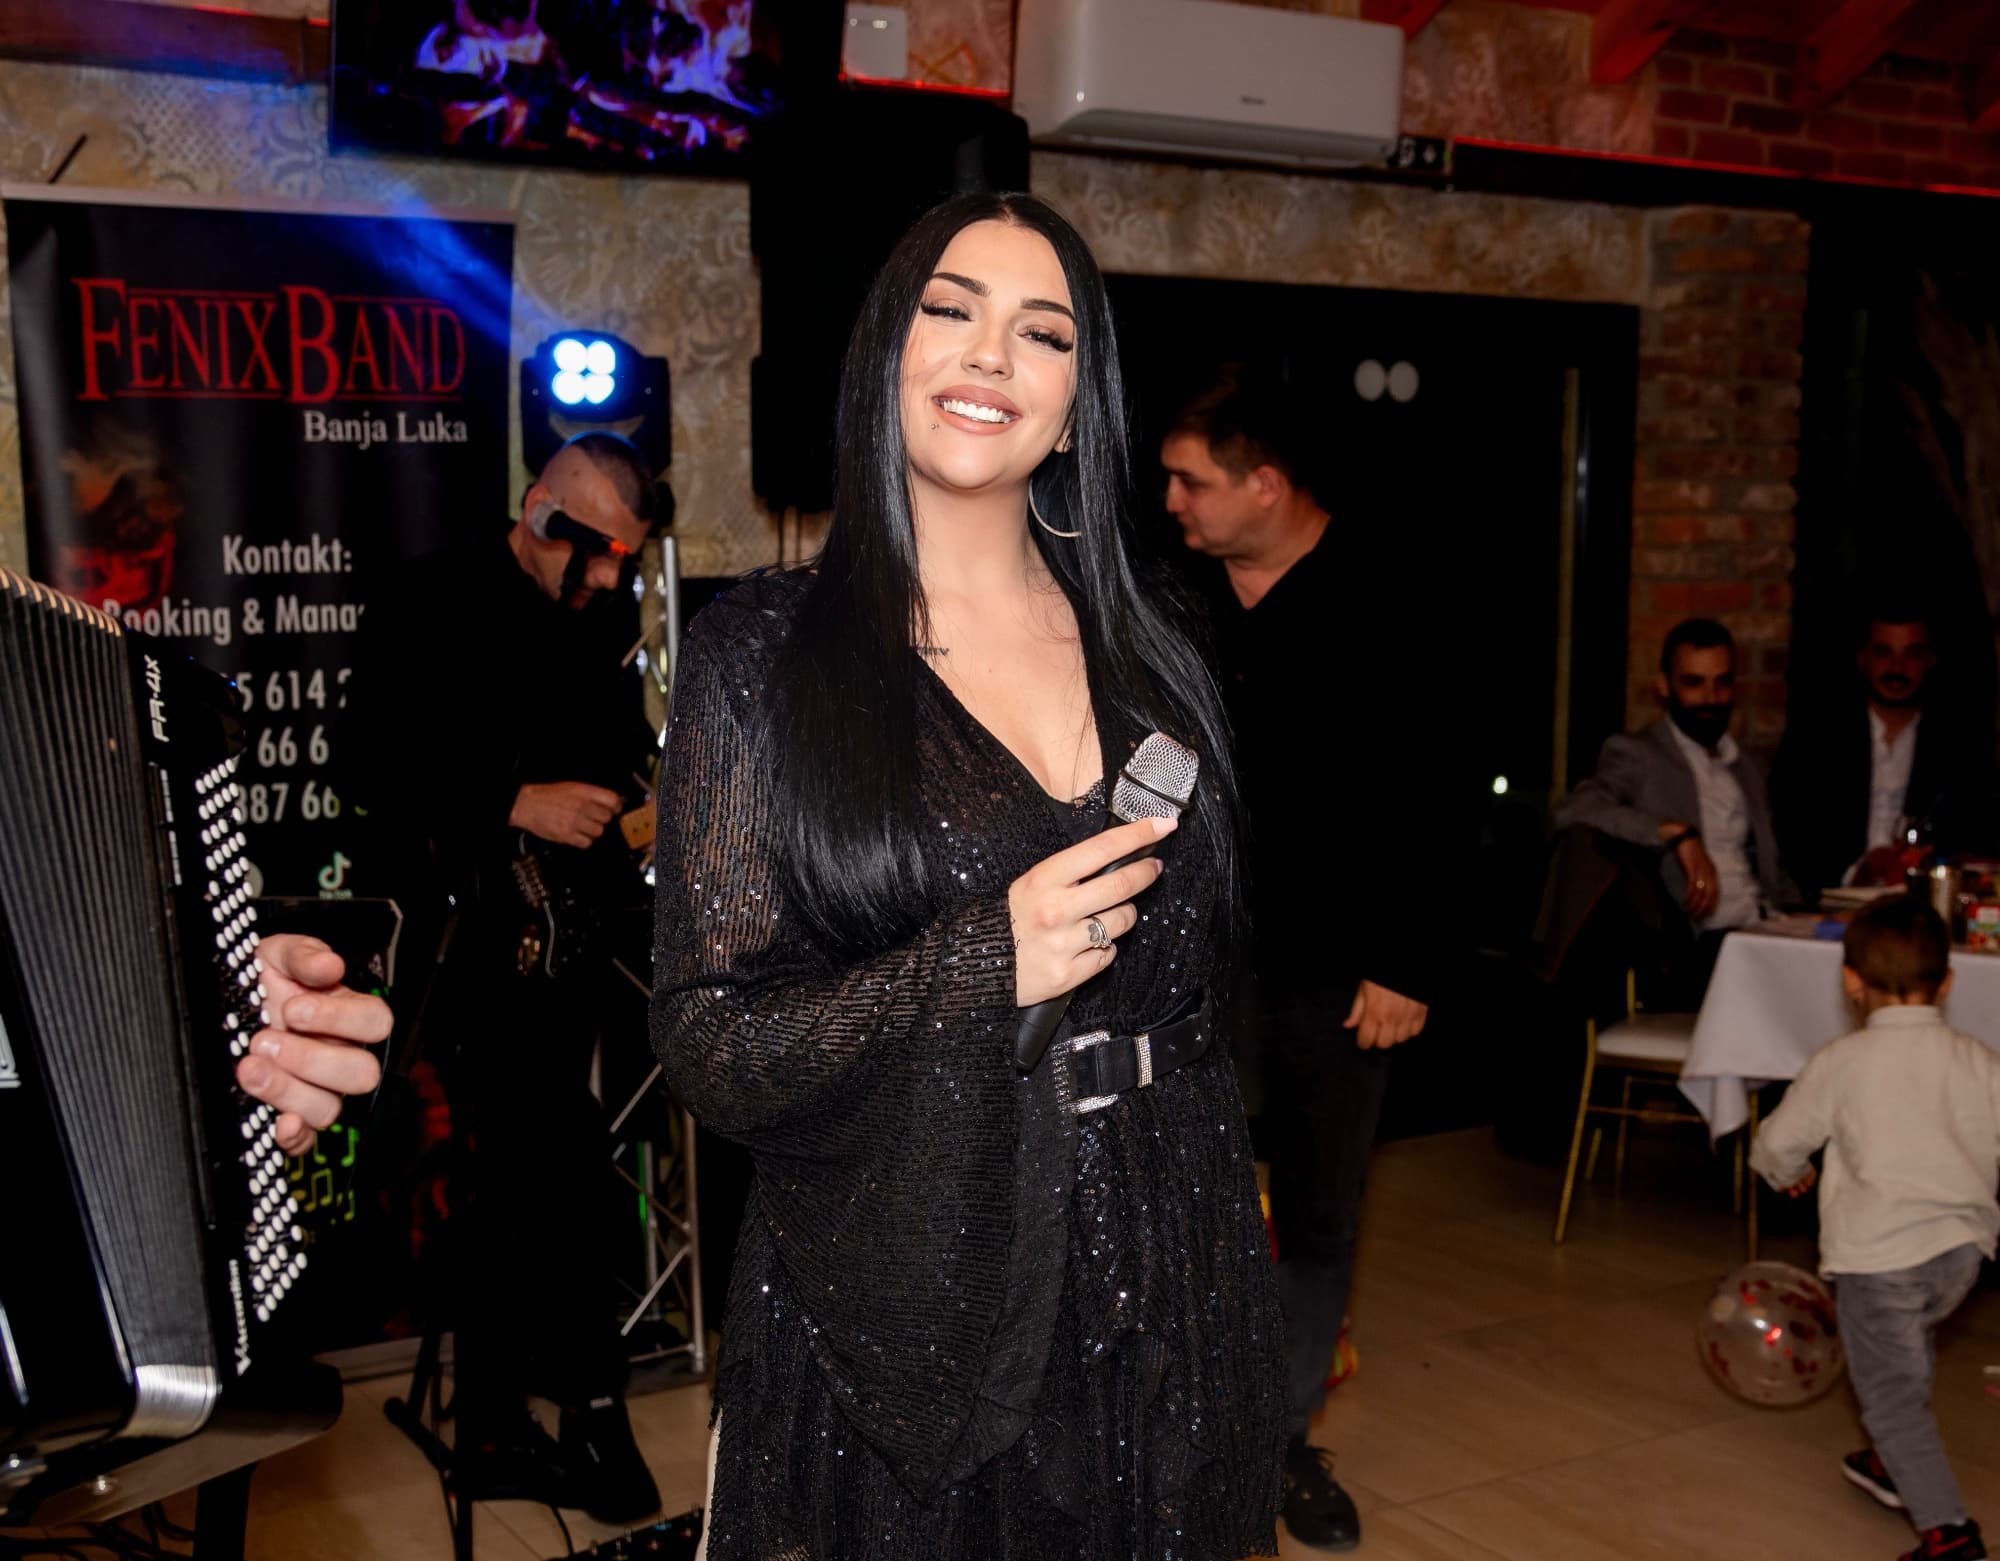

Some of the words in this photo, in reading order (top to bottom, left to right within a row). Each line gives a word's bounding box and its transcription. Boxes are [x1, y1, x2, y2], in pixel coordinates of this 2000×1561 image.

[303, 409, 389, 450] Banja
[396, 410, 468, 443] Luka
[222, 533, 352, 575] Kontakt:
[242, 597, 265, 635] &
[275, 594, 367, 634] Mana
[265, 668, 328, 712] 614
[256, 725, 299, 769] 66
[308, 723, 331, 766] 6
